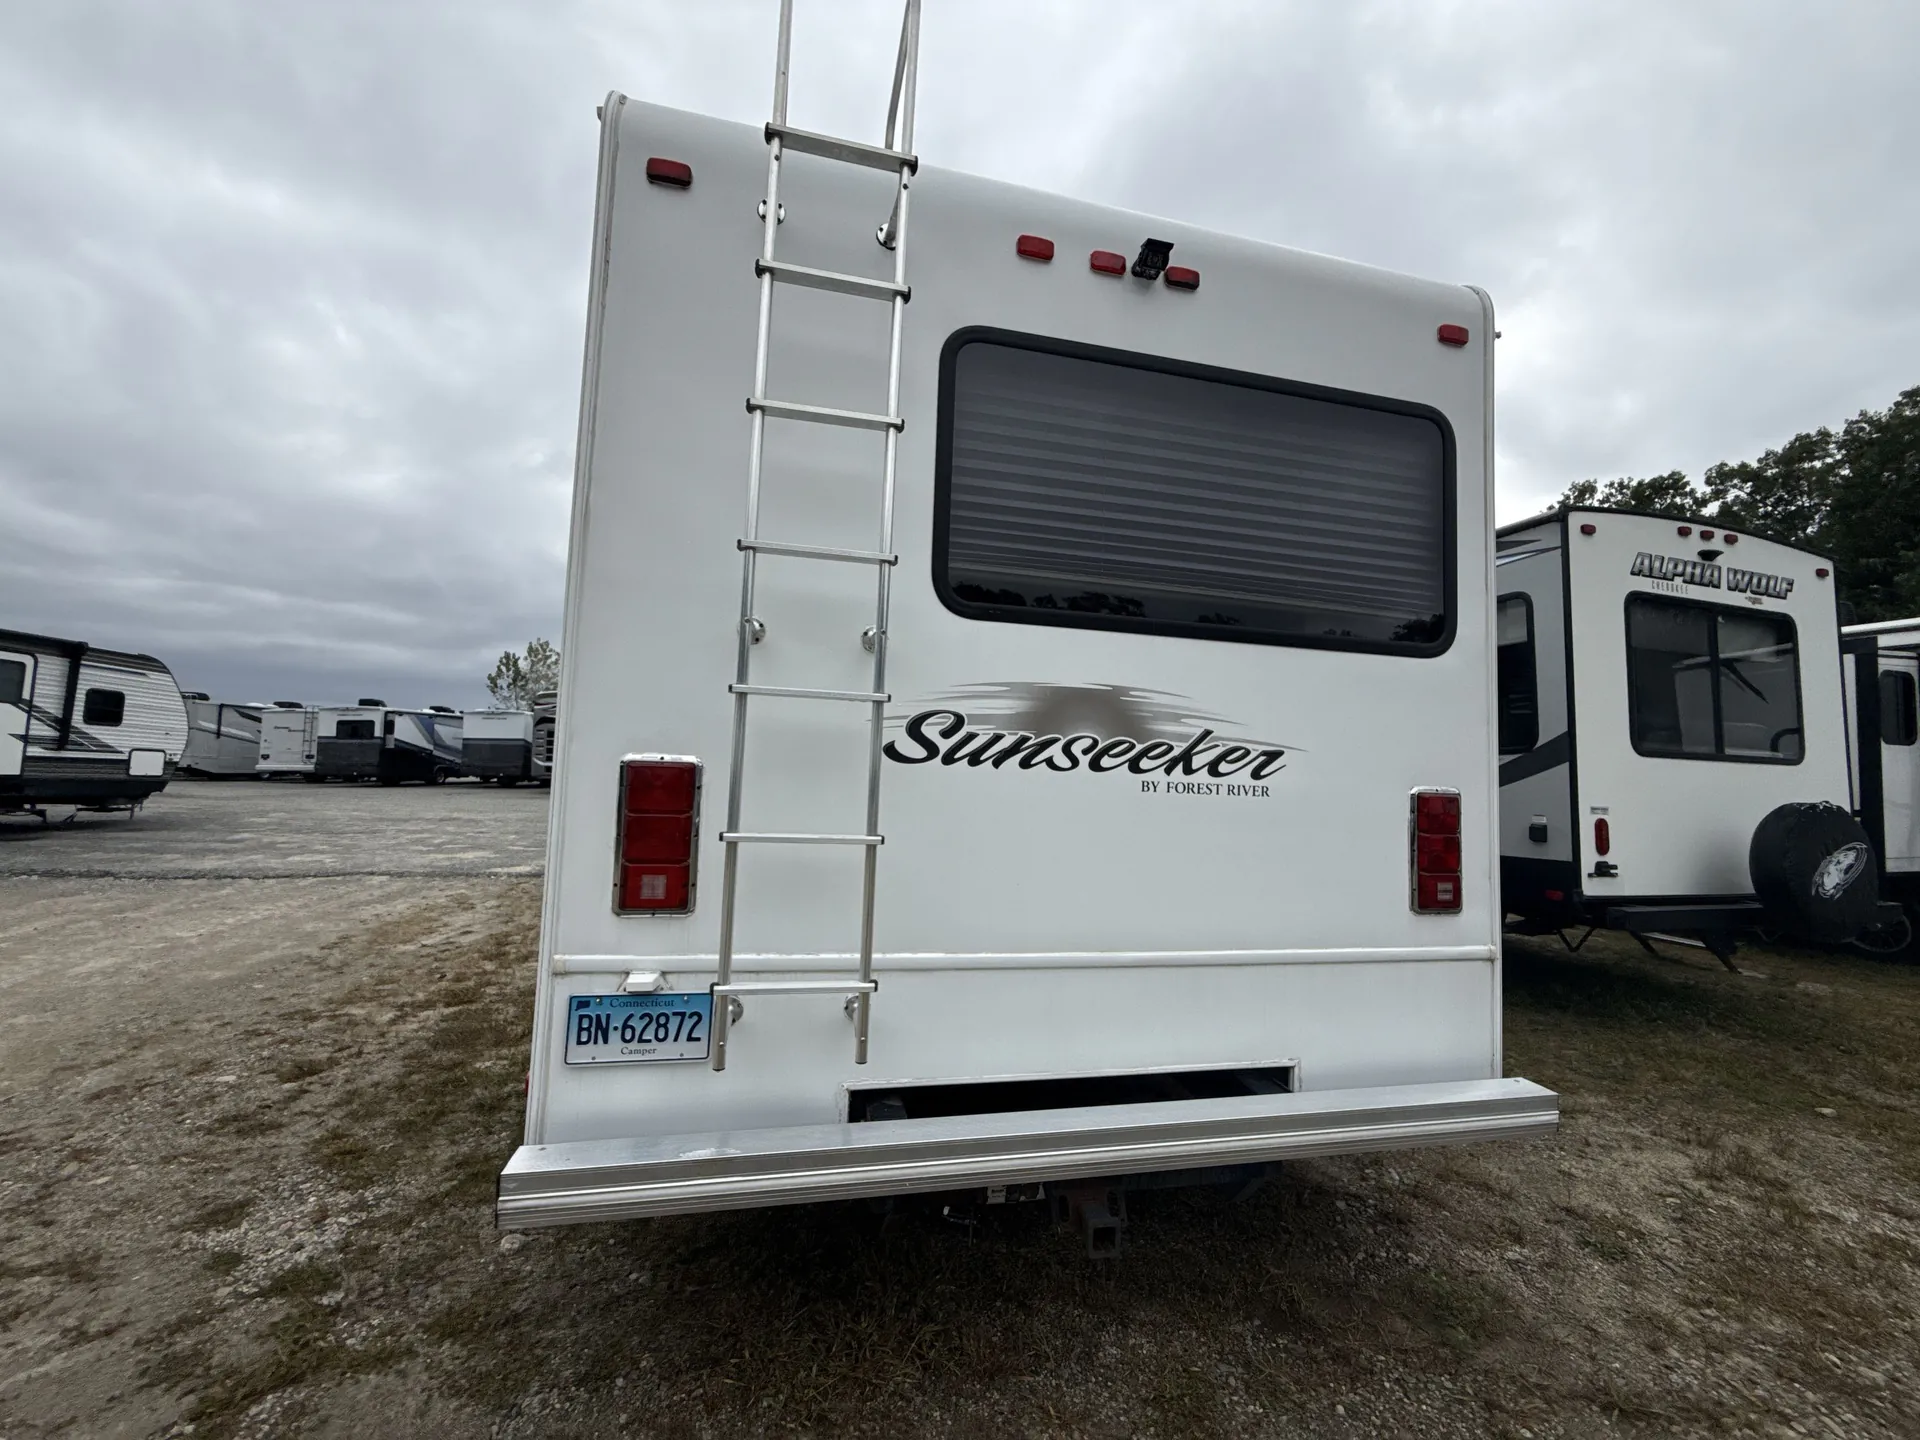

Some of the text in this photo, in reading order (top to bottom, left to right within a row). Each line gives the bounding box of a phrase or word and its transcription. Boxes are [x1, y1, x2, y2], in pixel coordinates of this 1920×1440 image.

[1630, 551, 1795, 600] ALPHA WOLF
[1651, 580, 1689, 595] CHEROKEE
[882, 709, 1287, 781] Sunseeker
[1141, 780, 1271, 798] BY FOREST RIVER
[609, 998, 676, 1009] Connecticut
[620, 1046, 658, 1057] Camper
